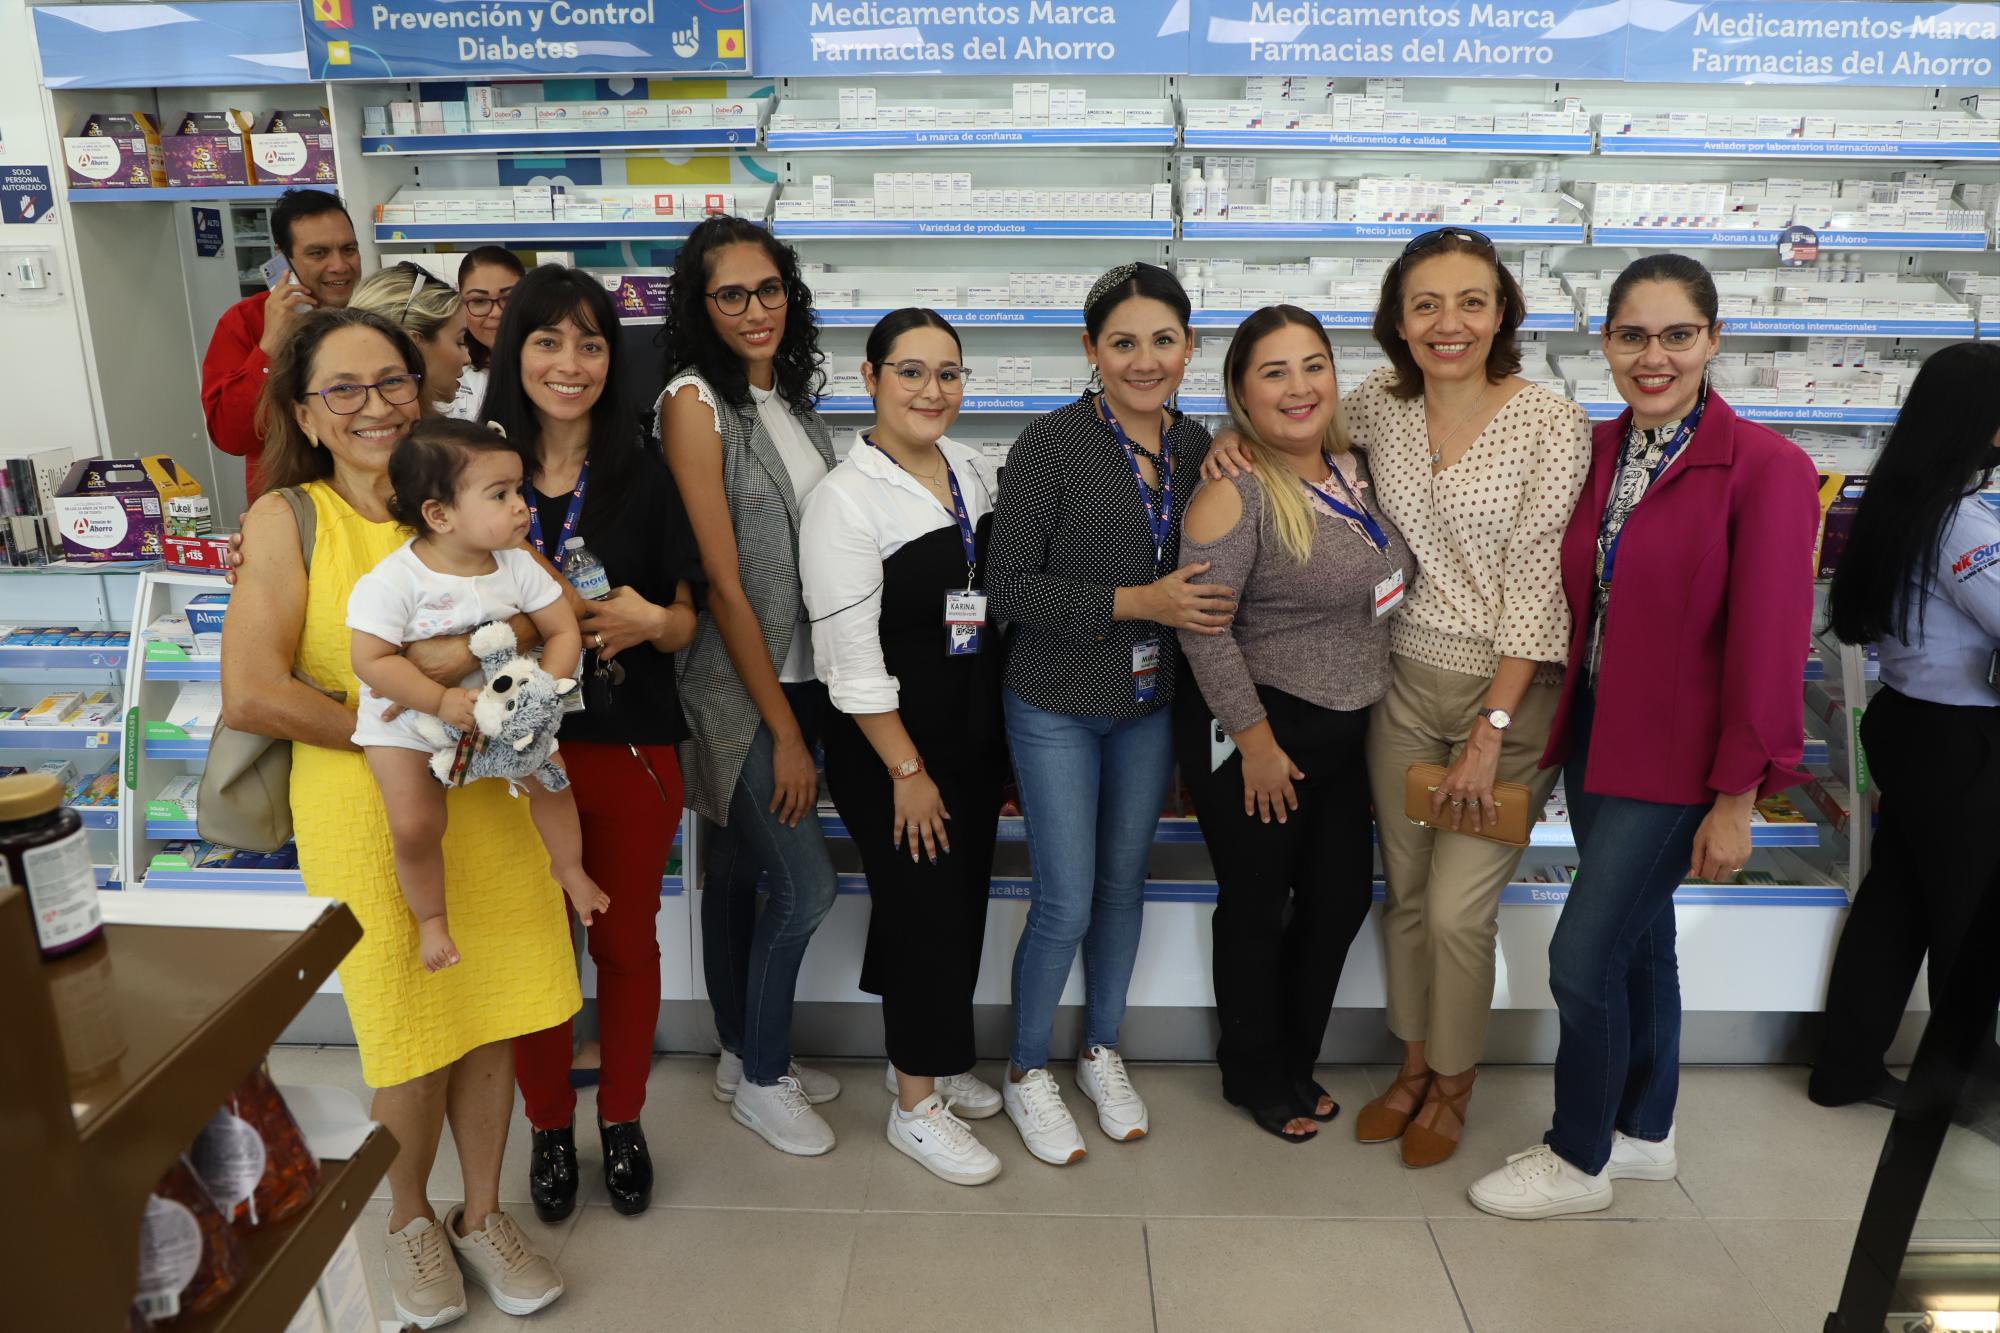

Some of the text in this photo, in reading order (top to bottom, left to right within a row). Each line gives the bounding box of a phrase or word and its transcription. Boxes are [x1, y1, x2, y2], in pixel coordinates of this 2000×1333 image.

[372, 0, 655, 32] Prevención y Control
[809, 1, 1116, 26] Medicamentos Marca
[1249, 2, 1556, 29] Medicamentos Marca
[1693, 12, 1997, 40] Medicamentos Marca
[459, 36, 578, 61] Diabetes
[811, 37, 1115, 62] Farmacias del Ahorro
[1250, 38, 1553, 65] Farmacias del Ahorro
[1691, 48, 1992, 76] Farmacias del Ahorro
[916, 132, 926, 141] La
[962, 132, 973, 142] de
[976, 131, 1022, 142] confianza
[1329, 134, 1448, 145] Medicamentos de calidad
[1703, 141, 1898, 154] Avalados por laboratorios internacionales
[918, 223, 1026, 234] Variedad de productos
[1356, 226, 1412, 236] Precio justo
[1712, 234, 1748, 242] Abonan
[1757, 234, 1768, 242] tu
[1818, 235, 1834, 244] del
[1836, 235, 1868, 244] Ahorro
[942, 312, 1024, 321] arca de confianza
[1322, 314, 1375, 323] Medicamen
[1732, 322, 1877, 332] por laboratorios internacionales
[964, 399, 1024, 410] de productos
[1748, 409, 1794, 418] Monedero
[1796, 409, 1810, 418] del
[1812, 410, 1844, 418] Ahorro
[1973, 542, 2000, 562] OUT
[128, 714, 136, 782] ESTOMACALES
[989, 884, 1030, 896] acales
